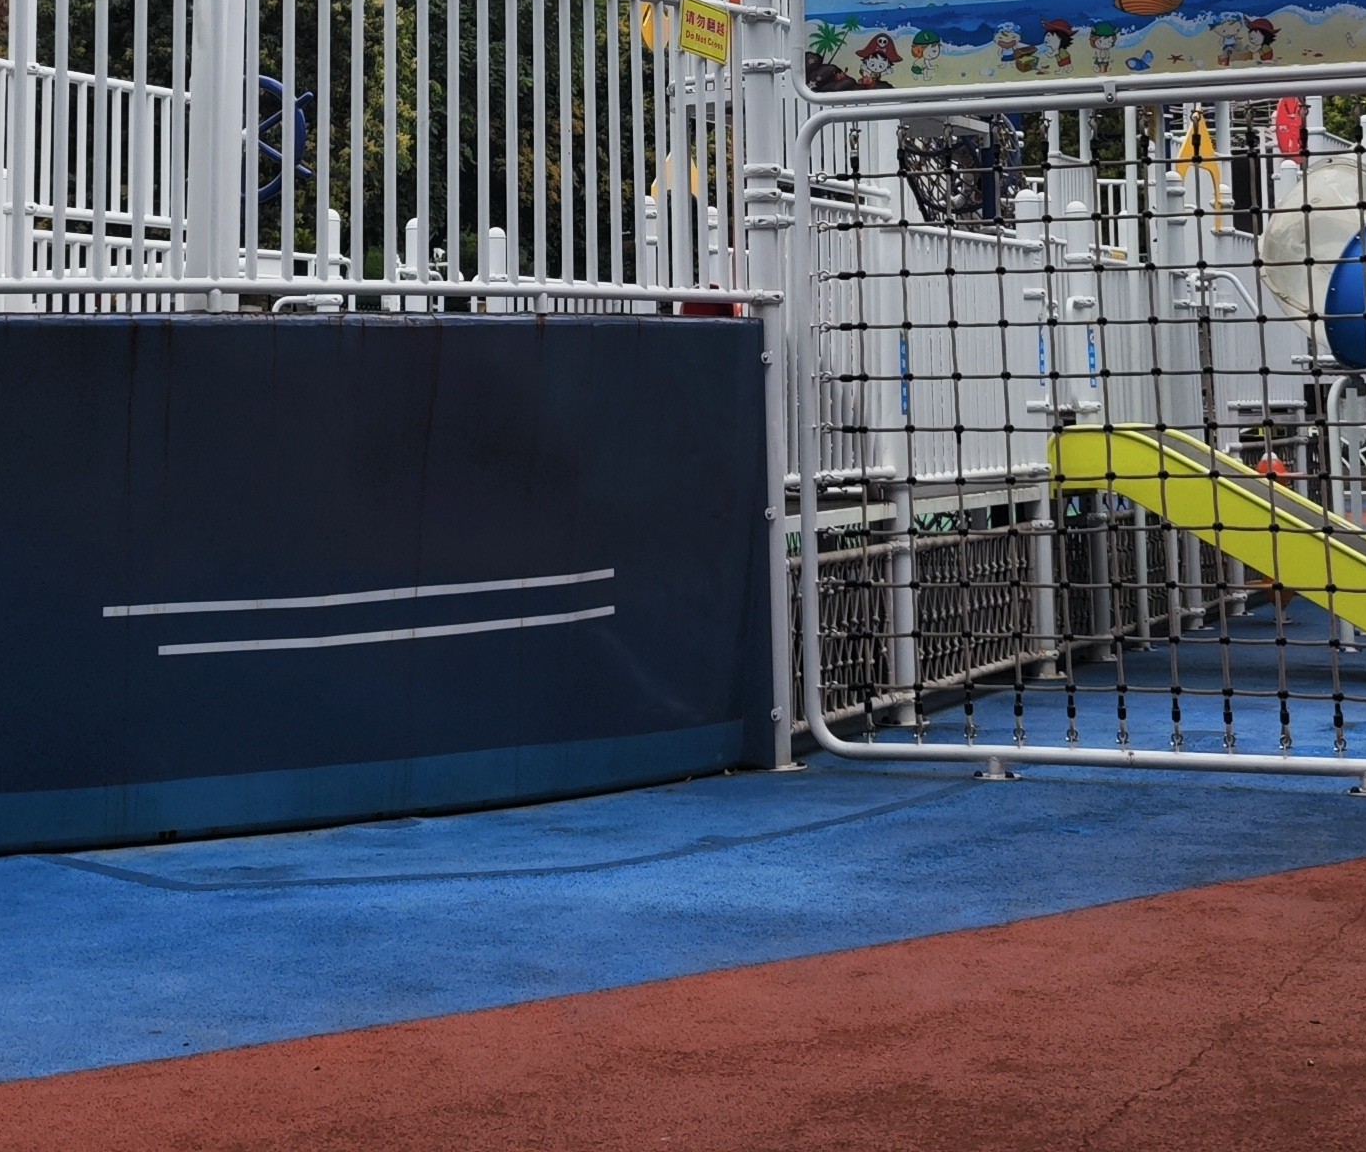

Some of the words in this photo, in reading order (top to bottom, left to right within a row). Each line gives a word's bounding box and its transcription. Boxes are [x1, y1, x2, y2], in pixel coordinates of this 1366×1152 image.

[686, 30, 694, 39] Do
[695, 33, 706, 44] Not
[707, 38, 723, 50] Cross
